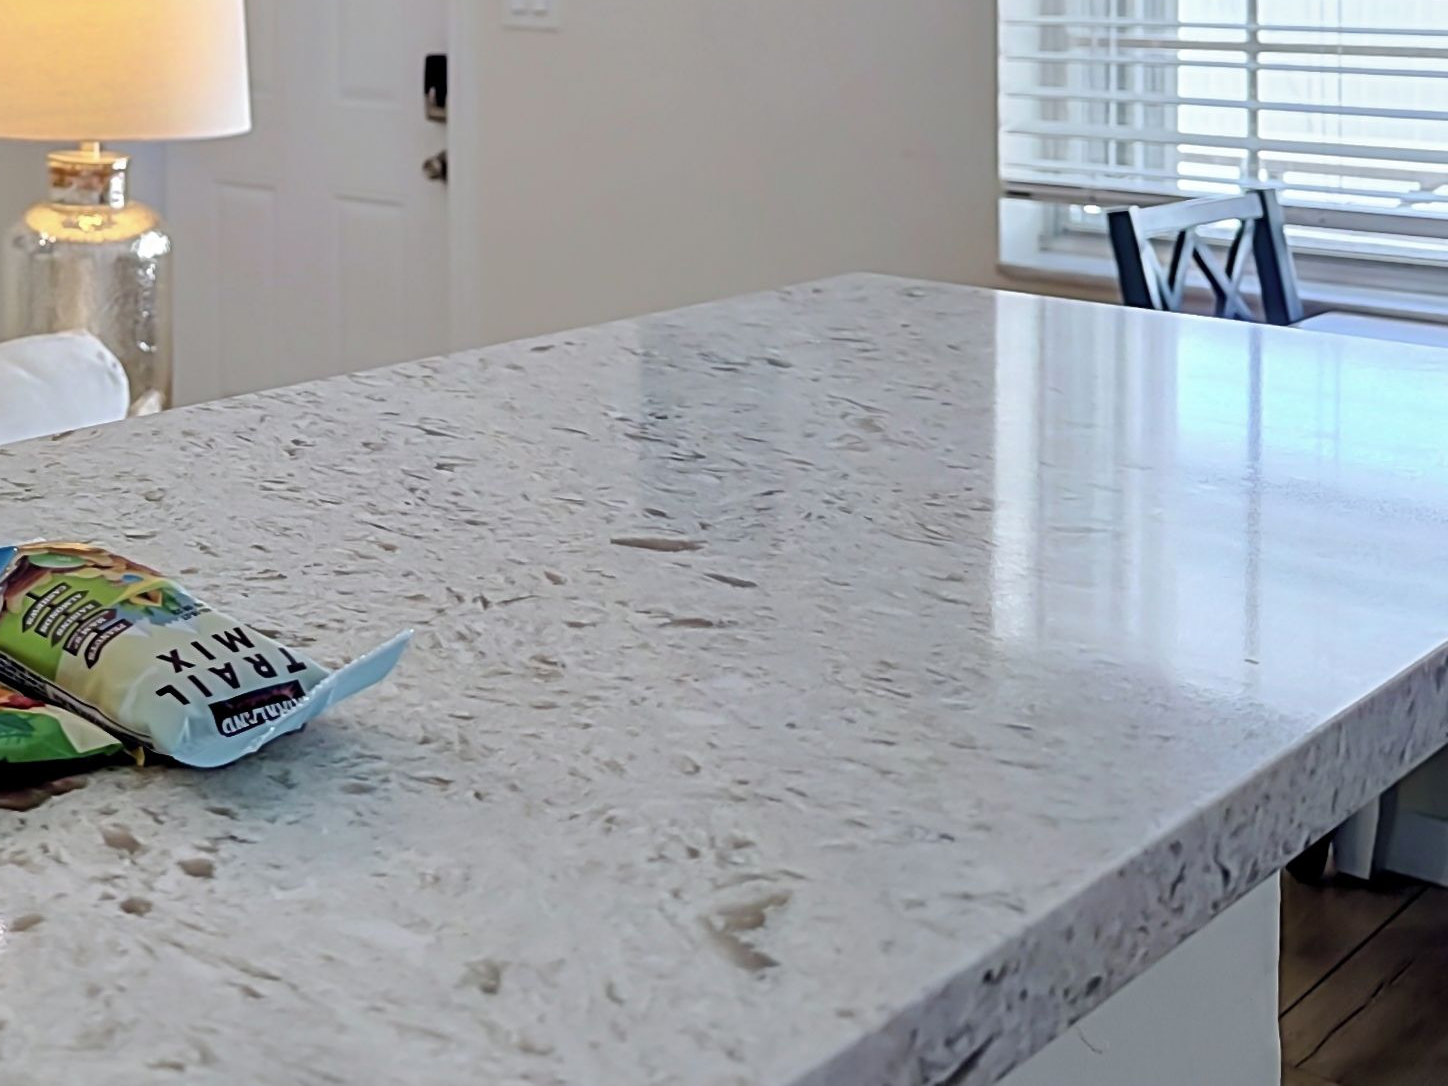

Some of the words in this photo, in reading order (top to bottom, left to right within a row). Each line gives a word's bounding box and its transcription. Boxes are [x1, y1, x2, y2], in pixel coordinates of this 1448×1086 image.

[25, 585, 68, 626] CASHEWS
[39, 593, 83, 634] ALMONDS
[156, 627, 256, 674] MIX
[155, 647, 307, 706] TRAIL
